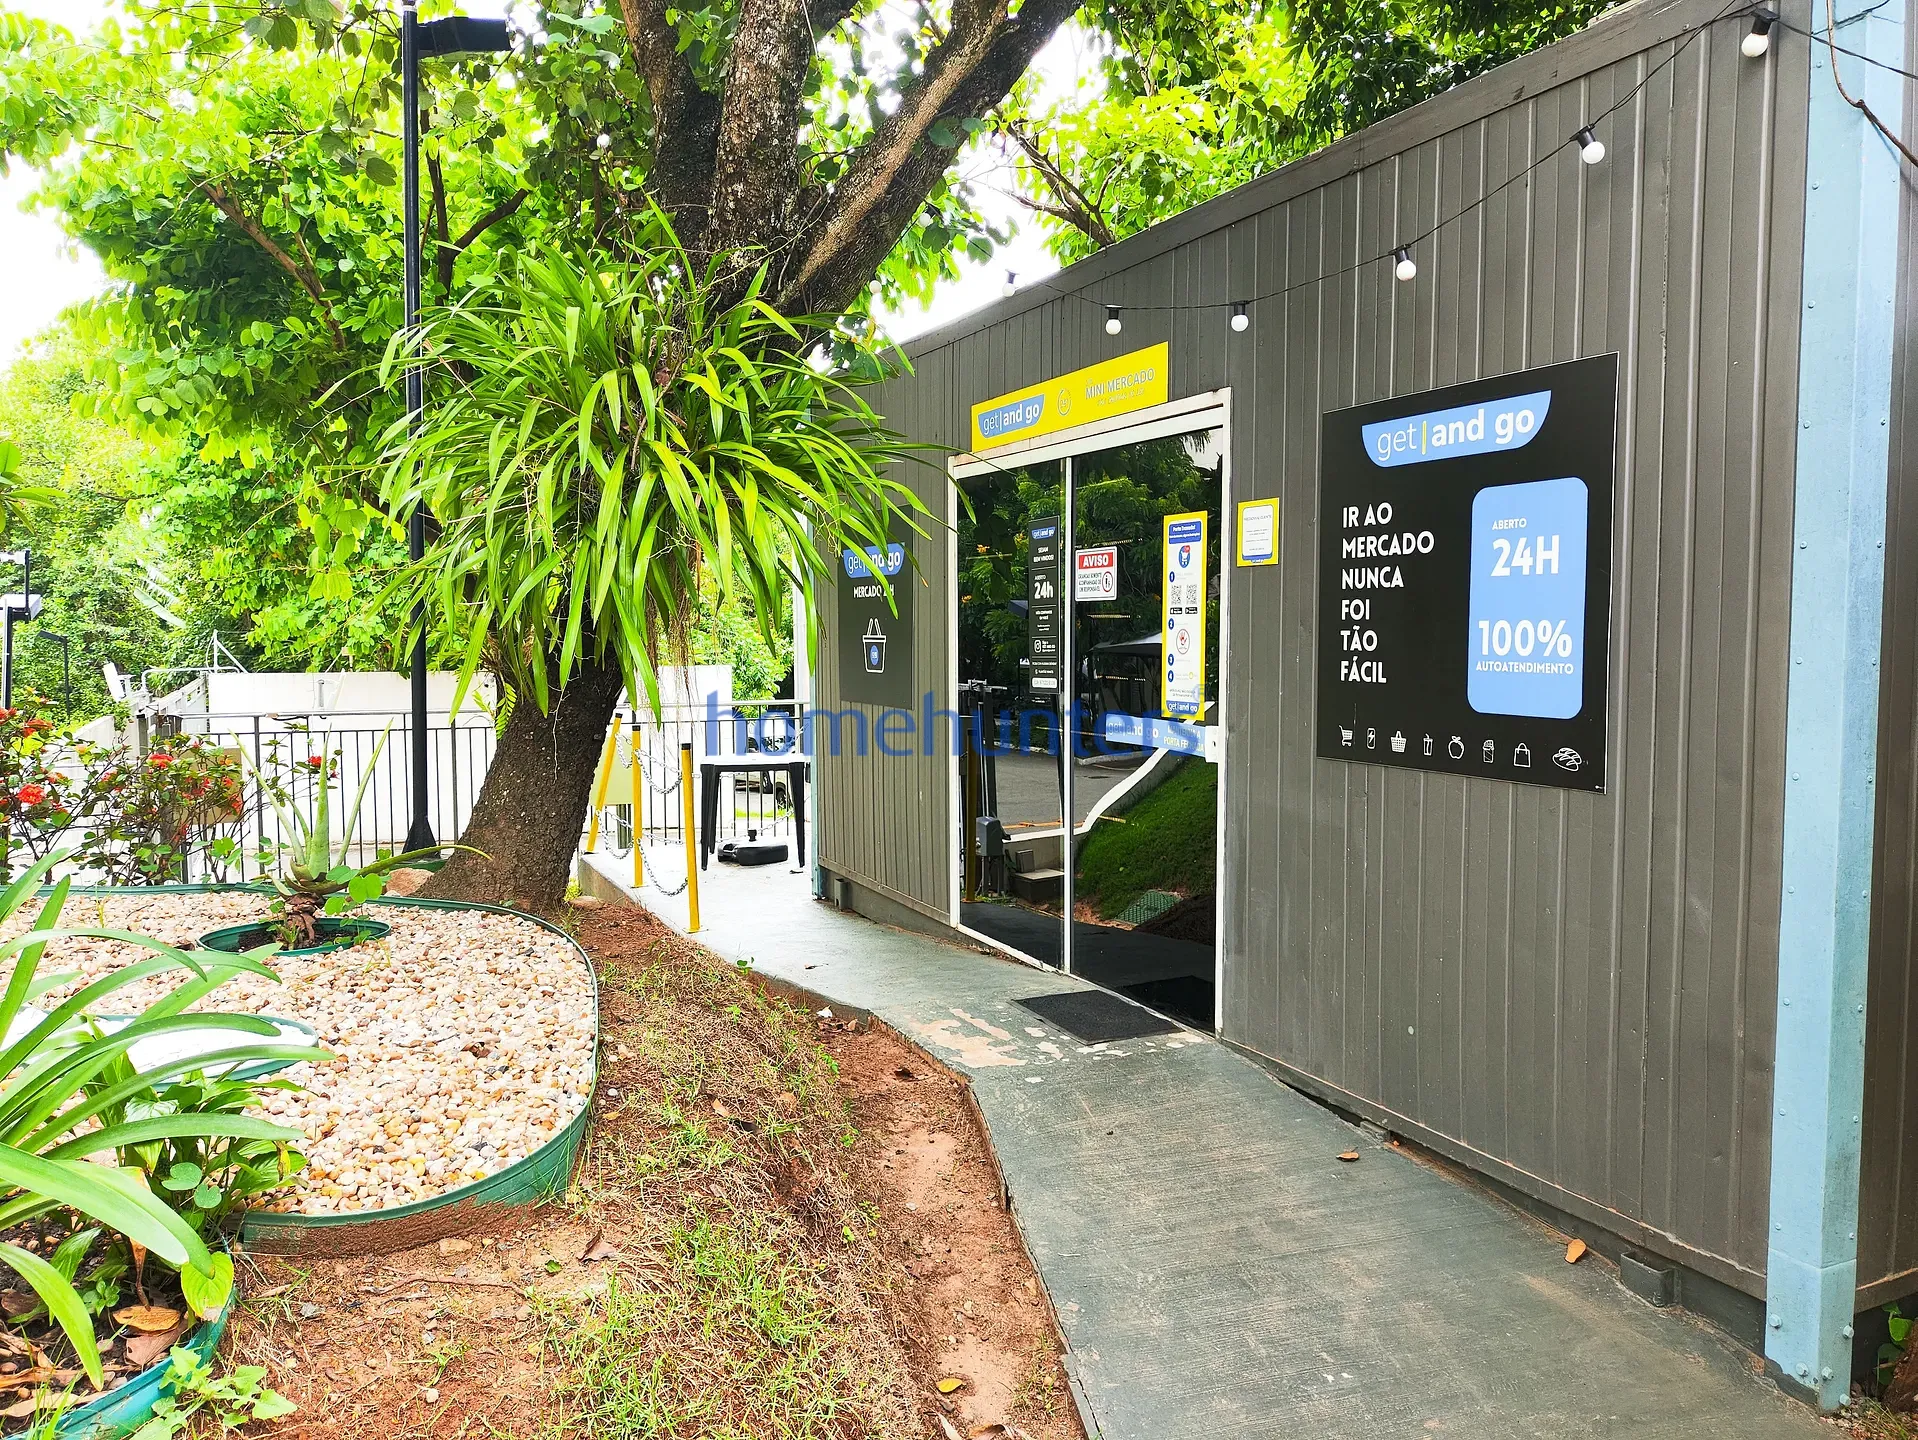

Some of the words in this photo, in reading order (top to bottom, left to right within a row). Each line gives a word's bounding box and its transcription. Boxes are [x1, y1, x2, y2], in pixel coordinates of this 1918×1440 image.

[1085, 384, 1104, 400] MINI
[1108, 368, 1155, 392] MERCADO
[984, 414, 999, 436] get
[1004, 405, 1022, 426] and
[1026, 404, 1040, 424] go
[1377, 423, 1417, 461] get
[1431, 408, 1485, 447] and
[1494, 409, 1535, 445] go
[1343, 506, 1359, 528] IR
[1364, 502, 1393, 527] AO
[1492, 517, 1527, 531] ABERTO
[1342, 530, 1435, 559] MERCADO
[1490, 534, 1561, 577] 24H
[888, 551, 900, 572] go
[1083, 554, 1109, 568] AVISO
[1034, 581, 1054, 600] 24h
[1341, 566, 1404, 590] NUNCA
[853, 585, 882, 598] MERCADO
[1341, 599, 1370, 620] FOI
[1340, 625, 1378, 652] TÃO
[1478, 619, 1573, 658] 100%
[1340, 656, 1387, 684] FÁCIL
[1476, 660, 1574, 675] AUTOATENDIMENTO
